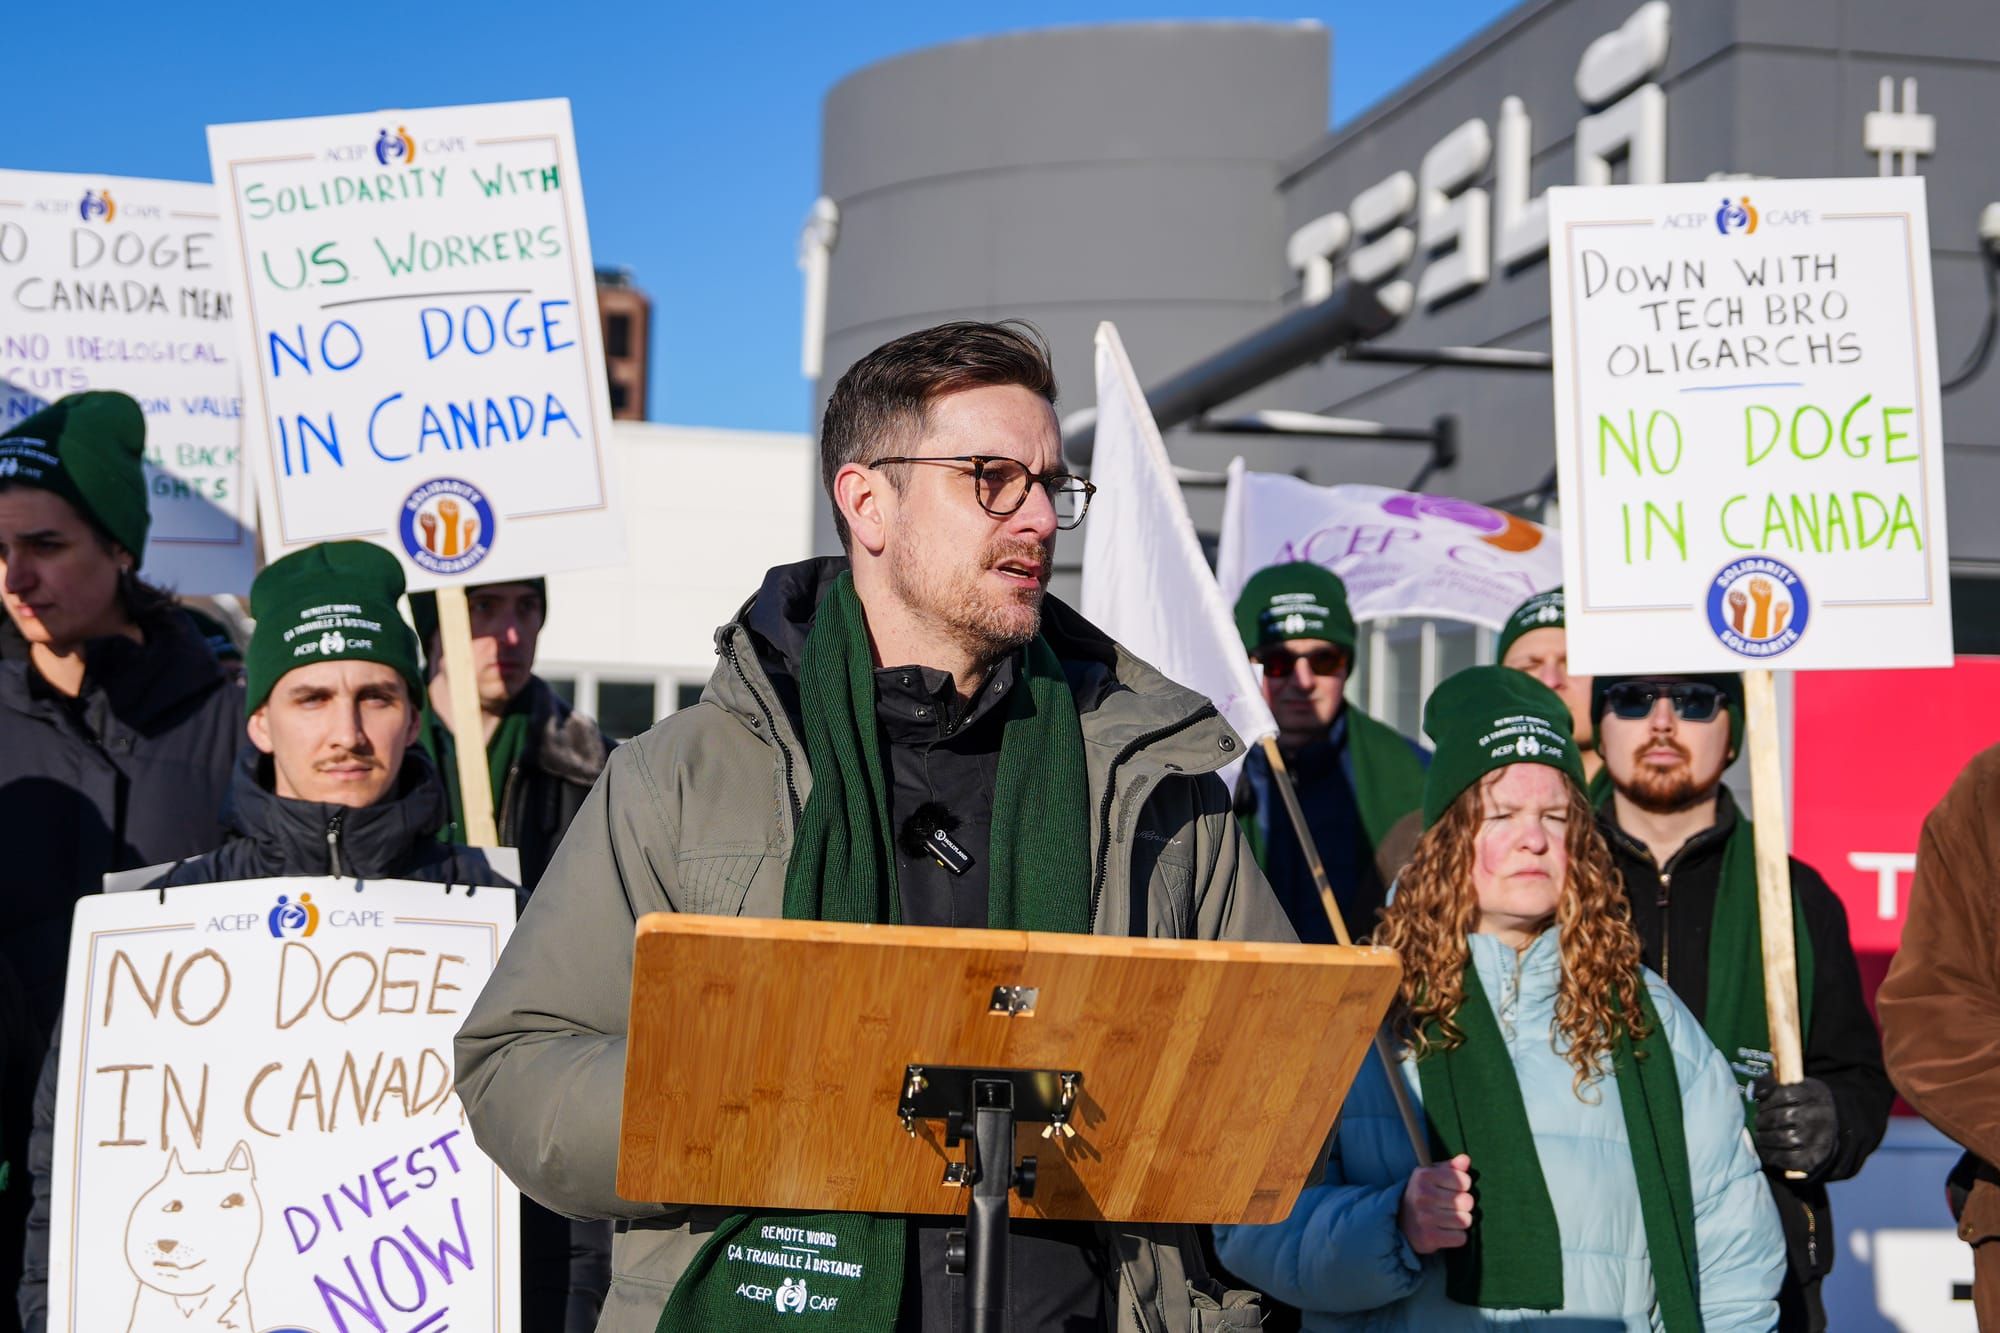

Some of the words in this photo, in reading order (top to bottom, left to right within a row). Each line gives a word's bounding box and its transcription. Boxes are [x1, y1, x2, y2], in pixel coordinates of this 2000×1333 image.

[325, 146, 368, 161] ACEP
[423, 137, 466, 153] CAPE
[1286, 0, 1671, 316] TESLA
[245, 166, 446, 219] SOLIDARITY
[472, 163, 559, 198] WITH
[1663, 213, 1707, 230] ACEP
[1766, 210, 1813, 226] CAPE
[0, 221, 28, 265] O
[70, 226, 214, 271] DOGE
[263, 241, 360, 290] U.S.
[374, 226, 561, 277] WORKERS
[14, 276, 169, 315] CANADA
[1582, 249, 1706, 298] DOWN
[1734, 253, 1838, 288] WITH
[1639, 297, 1744, 332] TECH
[1766, 289, 1849, 325] BRO
[6, 333, 50, 361] NO
[66, 335, 227, 364] IDEOLOGICAL
[269, 320, 363, 378] NO
[420, 298, 576, 361] DOGE
[1608, 331, 1862, 377] OLIGARCHS
[7, 366, 88, 391] CUTS
[181, 395, 241, 419] VALLE
[278, 411, 344, 476] IN
[369, 391, 582, 462] CANADA
[1599, 409, 1683, 477] NO
[1746, 393, 1921, 467] DOGE
[153, 475, 228, 500] GHTS
[1623, 501, 1687, 564] IN
[1720, 491, 1923, 552] CANADA
[1716, 559, 1797, 588] SOLIDARITY
[206, 913, 259, 933] ACEP
[329, 910, 384, 928] CAPE
[103, 947, 232, 1027] NO
[276, 941, 465, 1030] DOGE
[96, 1063, 209, 1151] IN
[284, 1129, 461, 1255] DIVEST
[761, 1225, 805, 1243] REMOTE
[806, 1230, 838, 1248] WORKS
[313, 1197, 475, 1333] NOW
[727, 1244, 743, 1261] ÇA
[746, 1248, 804, 1269] TRAVAILLE
[804, 1253, 811, 1270] À
[813, 1259, 863, 1278] DISTANCE
[736, 1282, 773, 1301] ACEP
